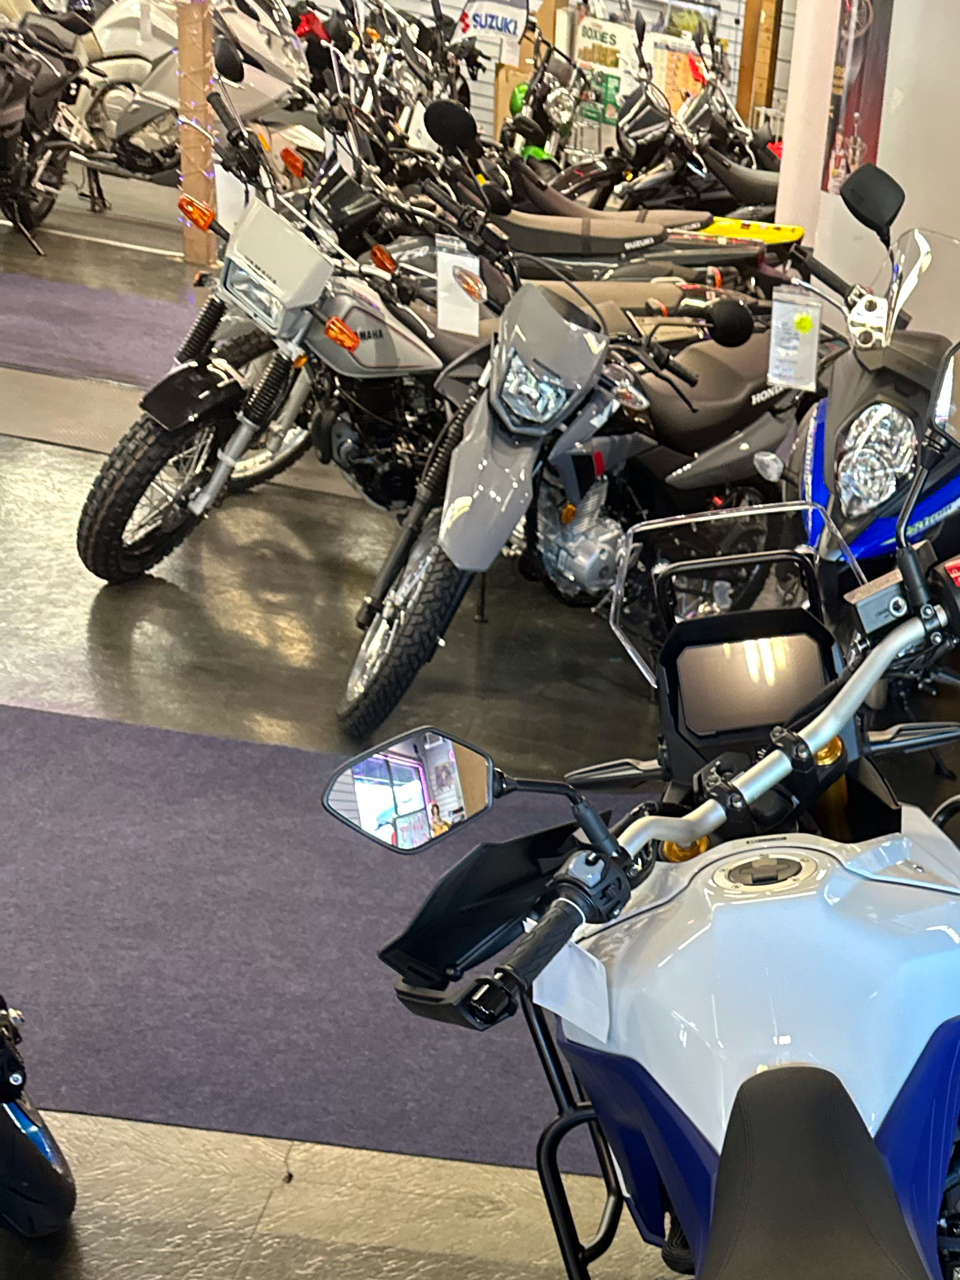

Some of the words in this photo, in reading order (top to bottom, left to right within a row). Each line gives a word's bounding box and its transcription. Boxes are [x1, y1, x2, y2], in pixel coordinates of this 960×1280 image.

[472, 12, 518, 36] SUZUKI
[624, 236, 655, 251] SUZUKI
[751, 385, 785, 406] HOND
